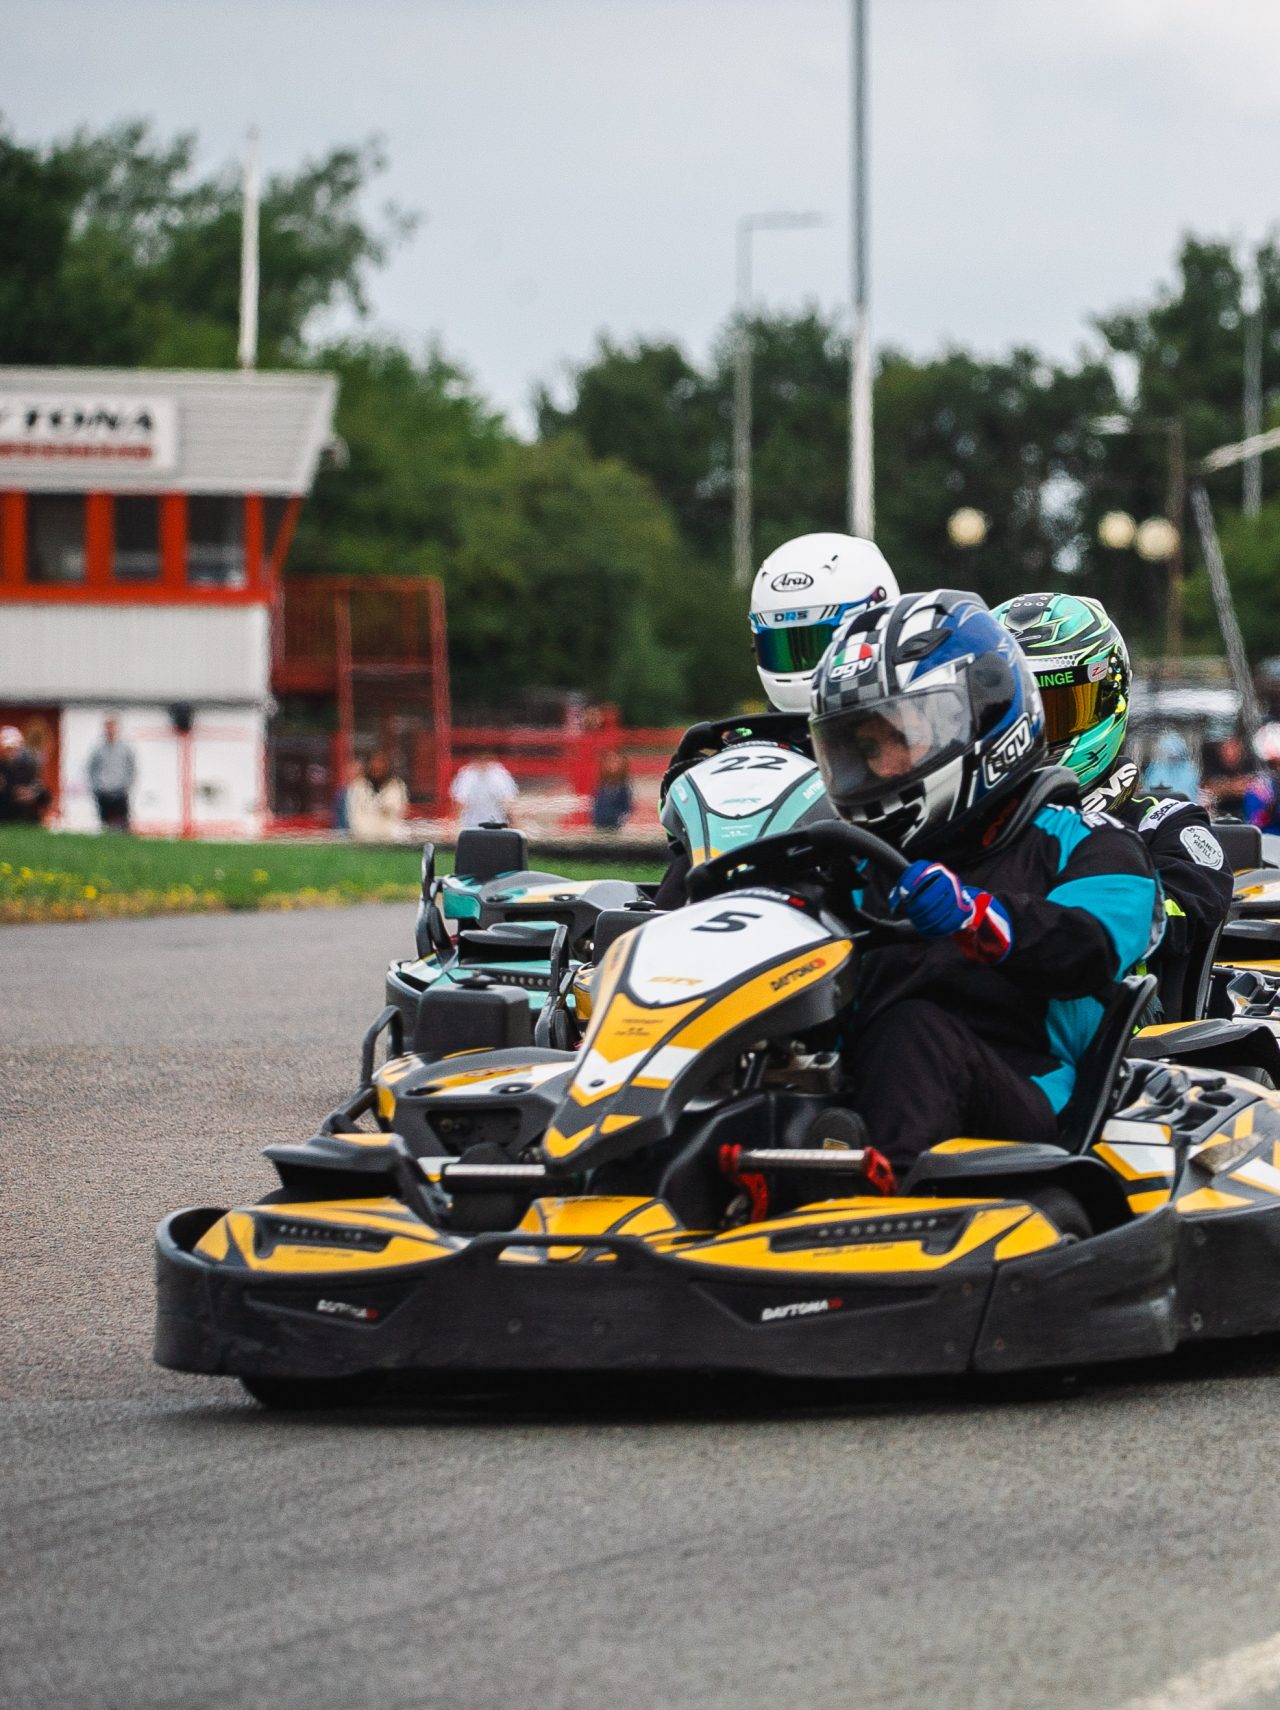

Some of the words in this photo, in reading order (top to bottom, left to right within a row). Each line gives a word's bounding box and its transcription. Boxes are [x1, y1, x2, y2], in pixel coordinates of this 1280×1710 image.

[774, 610, 809, 622] DRS
[710, 755, 788, 775] 22
[1192, 833, 1217, 855] PLANET
[1193, 839, 1211, 859] REFILL
[690, 910, 763, 933] 5
